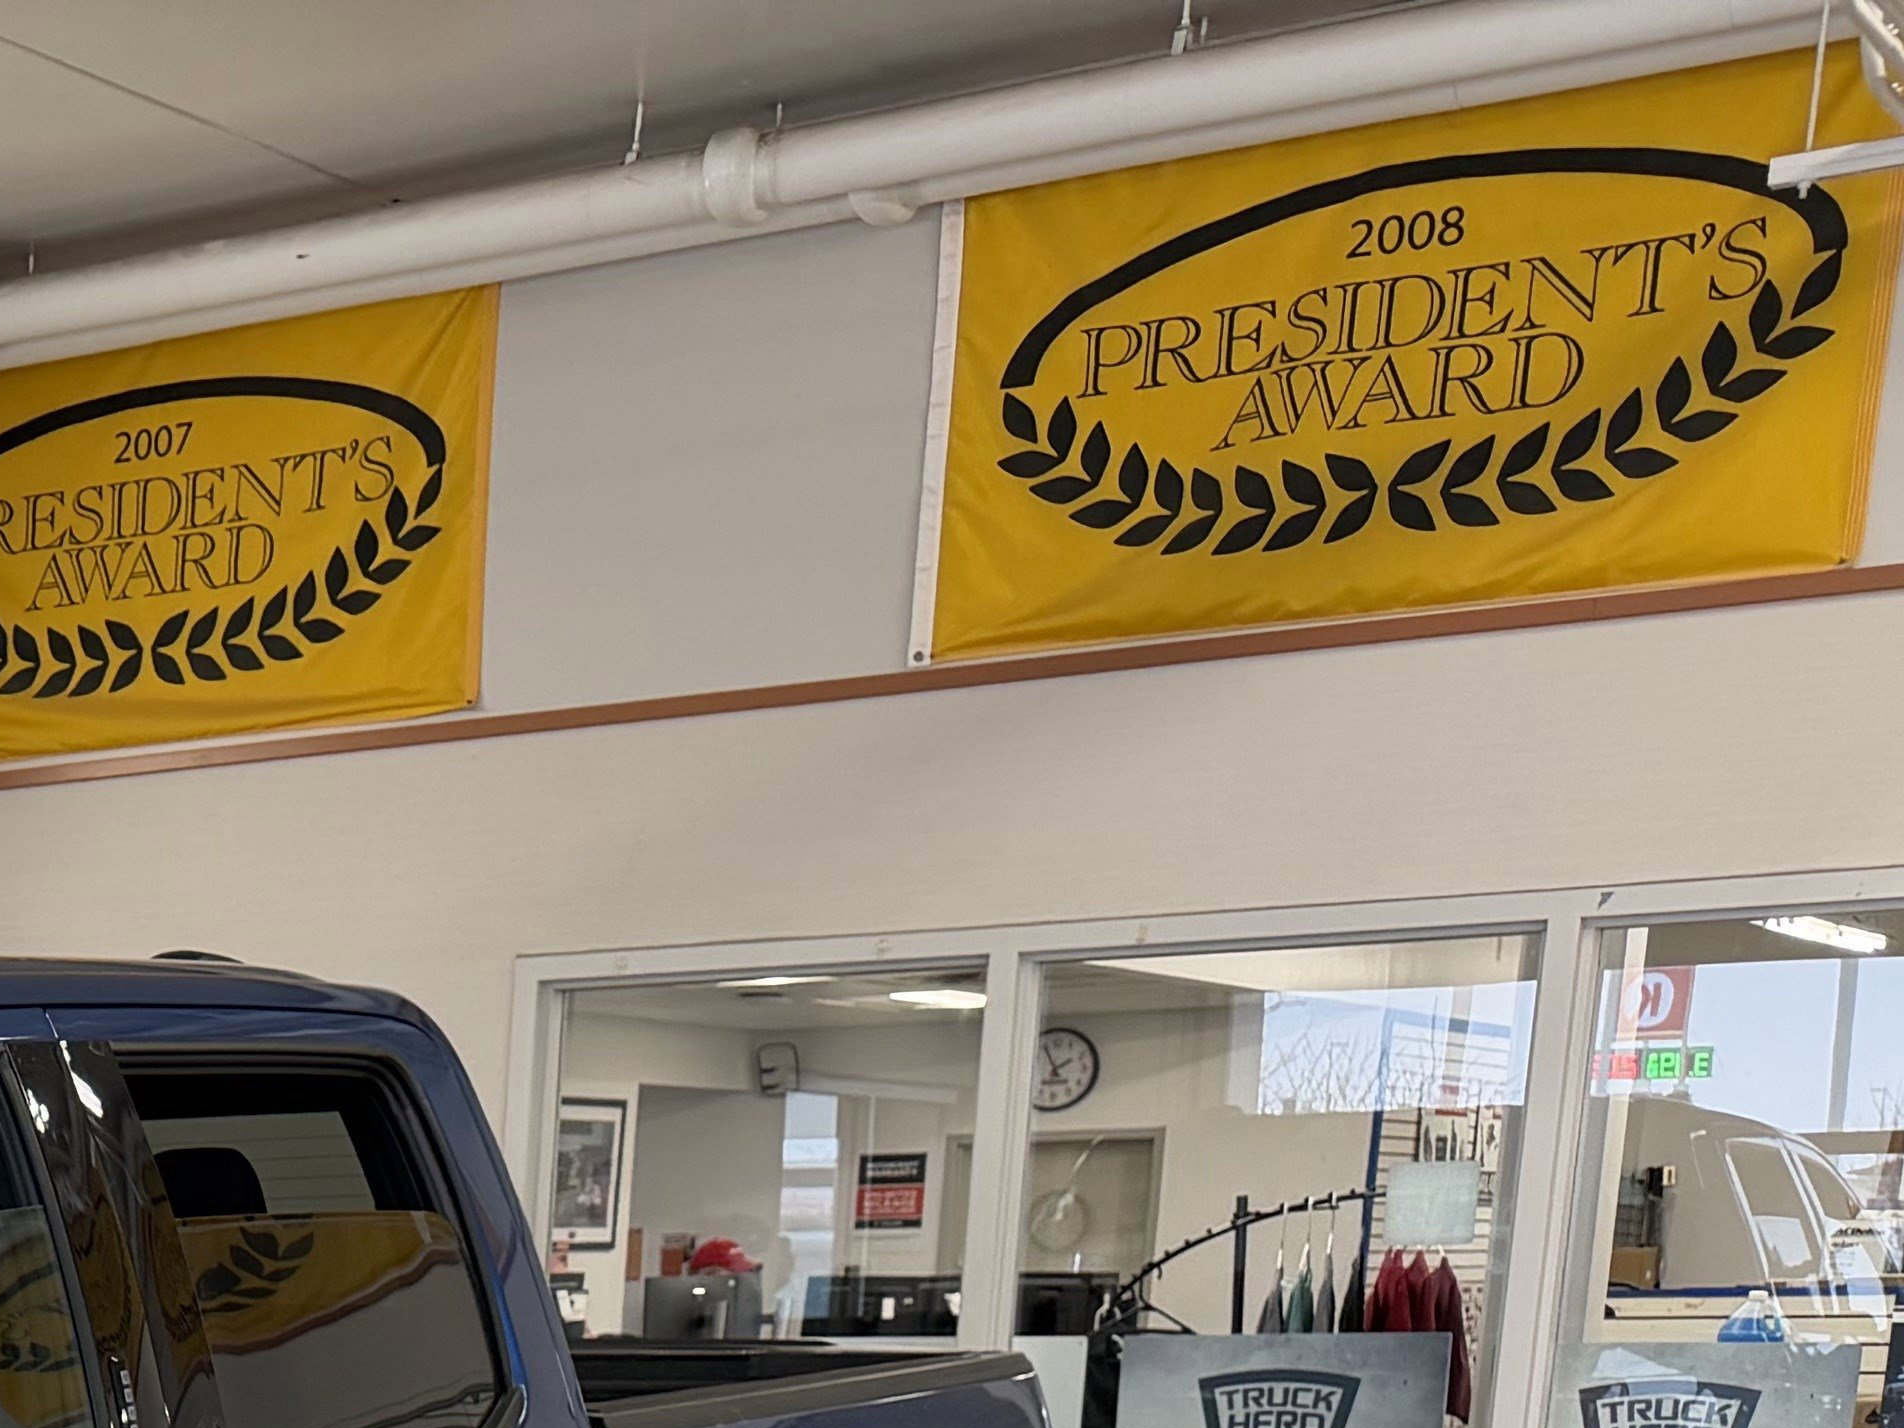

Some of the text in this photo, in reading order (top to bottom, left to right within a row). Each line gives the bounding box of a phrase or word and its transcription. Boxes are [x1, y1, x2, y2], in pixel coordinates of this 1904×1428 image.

[1344, 204, 1465, 260] 2008
[1075, 215, 1772, 400] PRESIDENT'S
[1209, 332, 1586, 453] AWARD
[114, 421, 193, 465] 2007
[24, 524, 275, 612] AWARD
[1219, 1387, 1338, 1413] TRUCK
[1601, 1398, 1732, 1427] TRUCK
